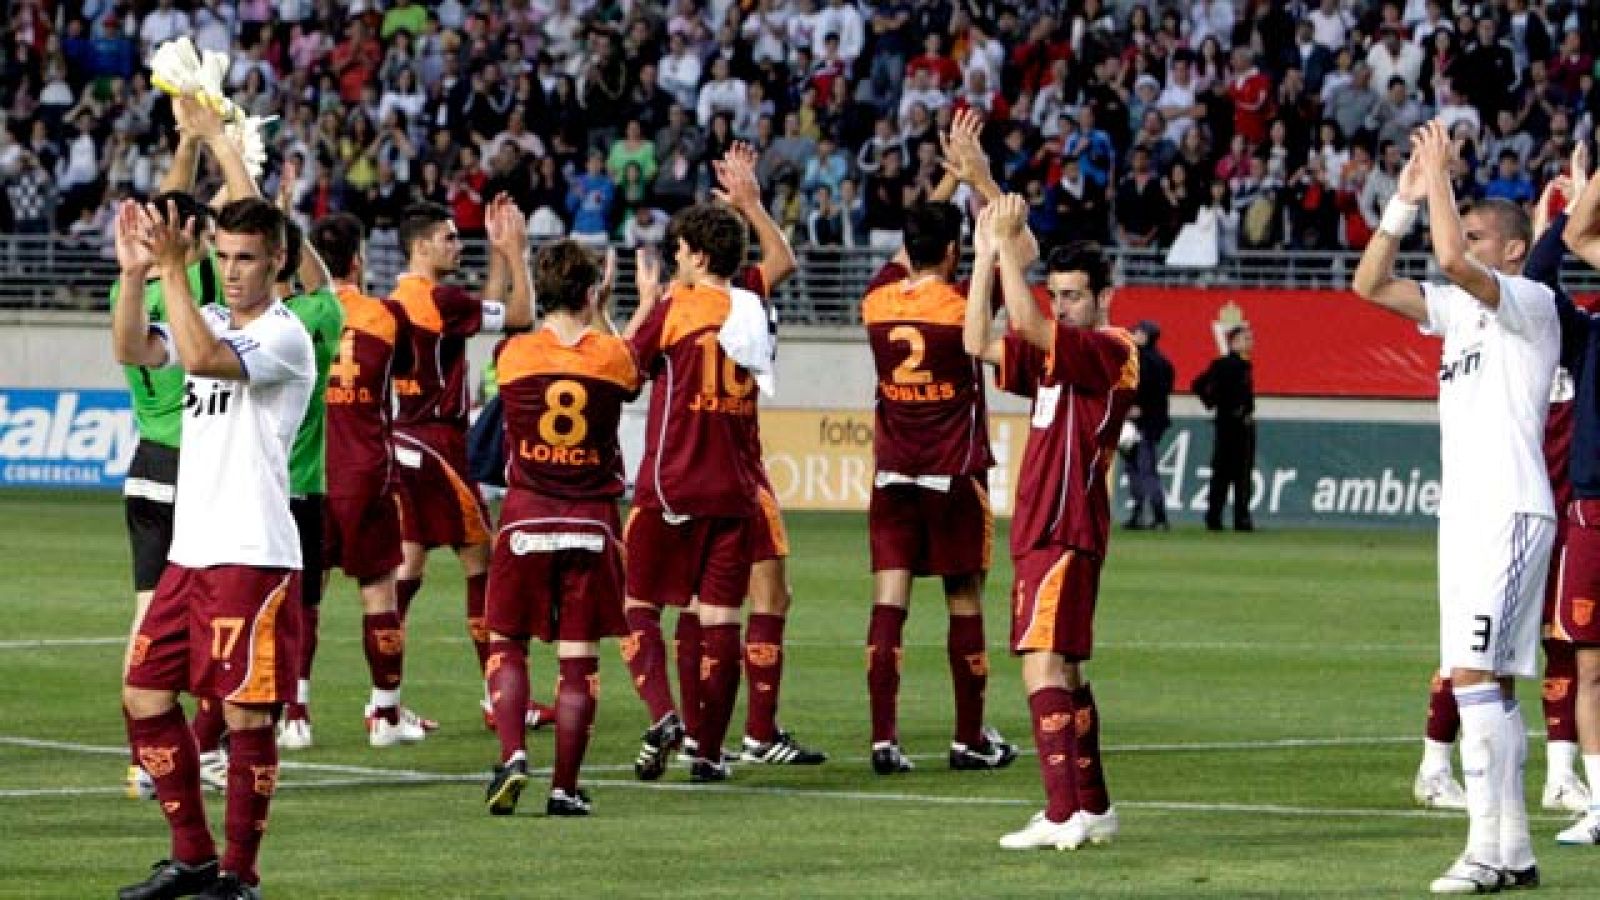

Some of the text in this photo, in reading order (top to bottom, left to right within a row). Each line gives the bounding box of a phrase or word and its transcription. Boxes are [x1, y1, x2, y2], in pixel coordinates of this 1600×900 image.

[888, 325, 933, 384] 2
[539, 380, 588, 446] 8
[4, 464, 101, 482] COMERCIAL
[520, 440, 600, 466] LORCA
[210, 617, 245, 660] 17
[1470, 614, 1491, 653] 3
